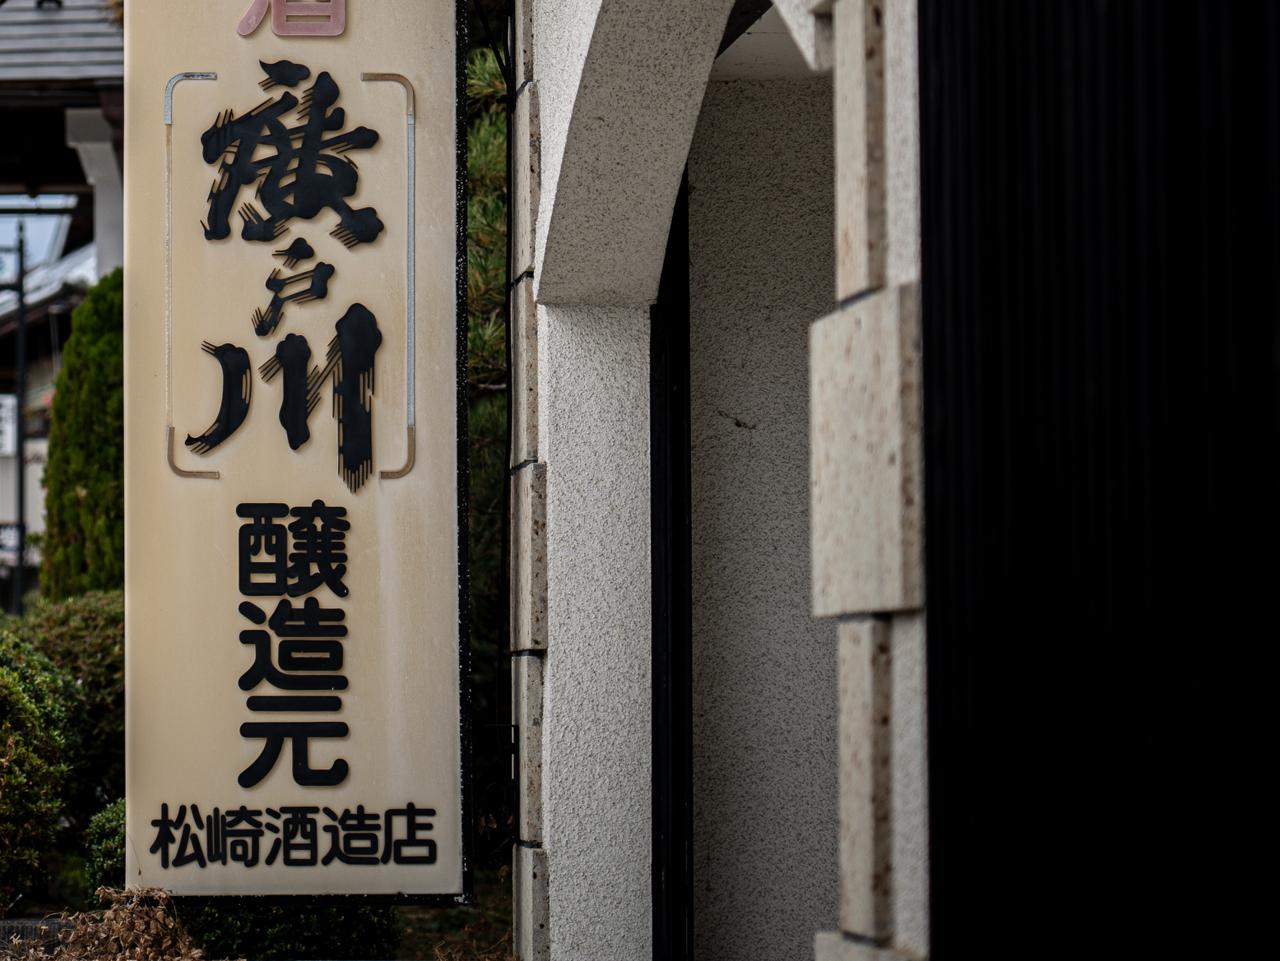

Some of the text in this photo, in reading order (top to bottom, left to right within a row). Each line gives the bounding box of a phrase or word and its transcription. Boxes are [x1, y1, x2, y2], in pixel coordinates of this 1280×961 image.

[236, 499, 350, 788] 醸造元
[150, 802, 437, 868] 松崎酒造店
